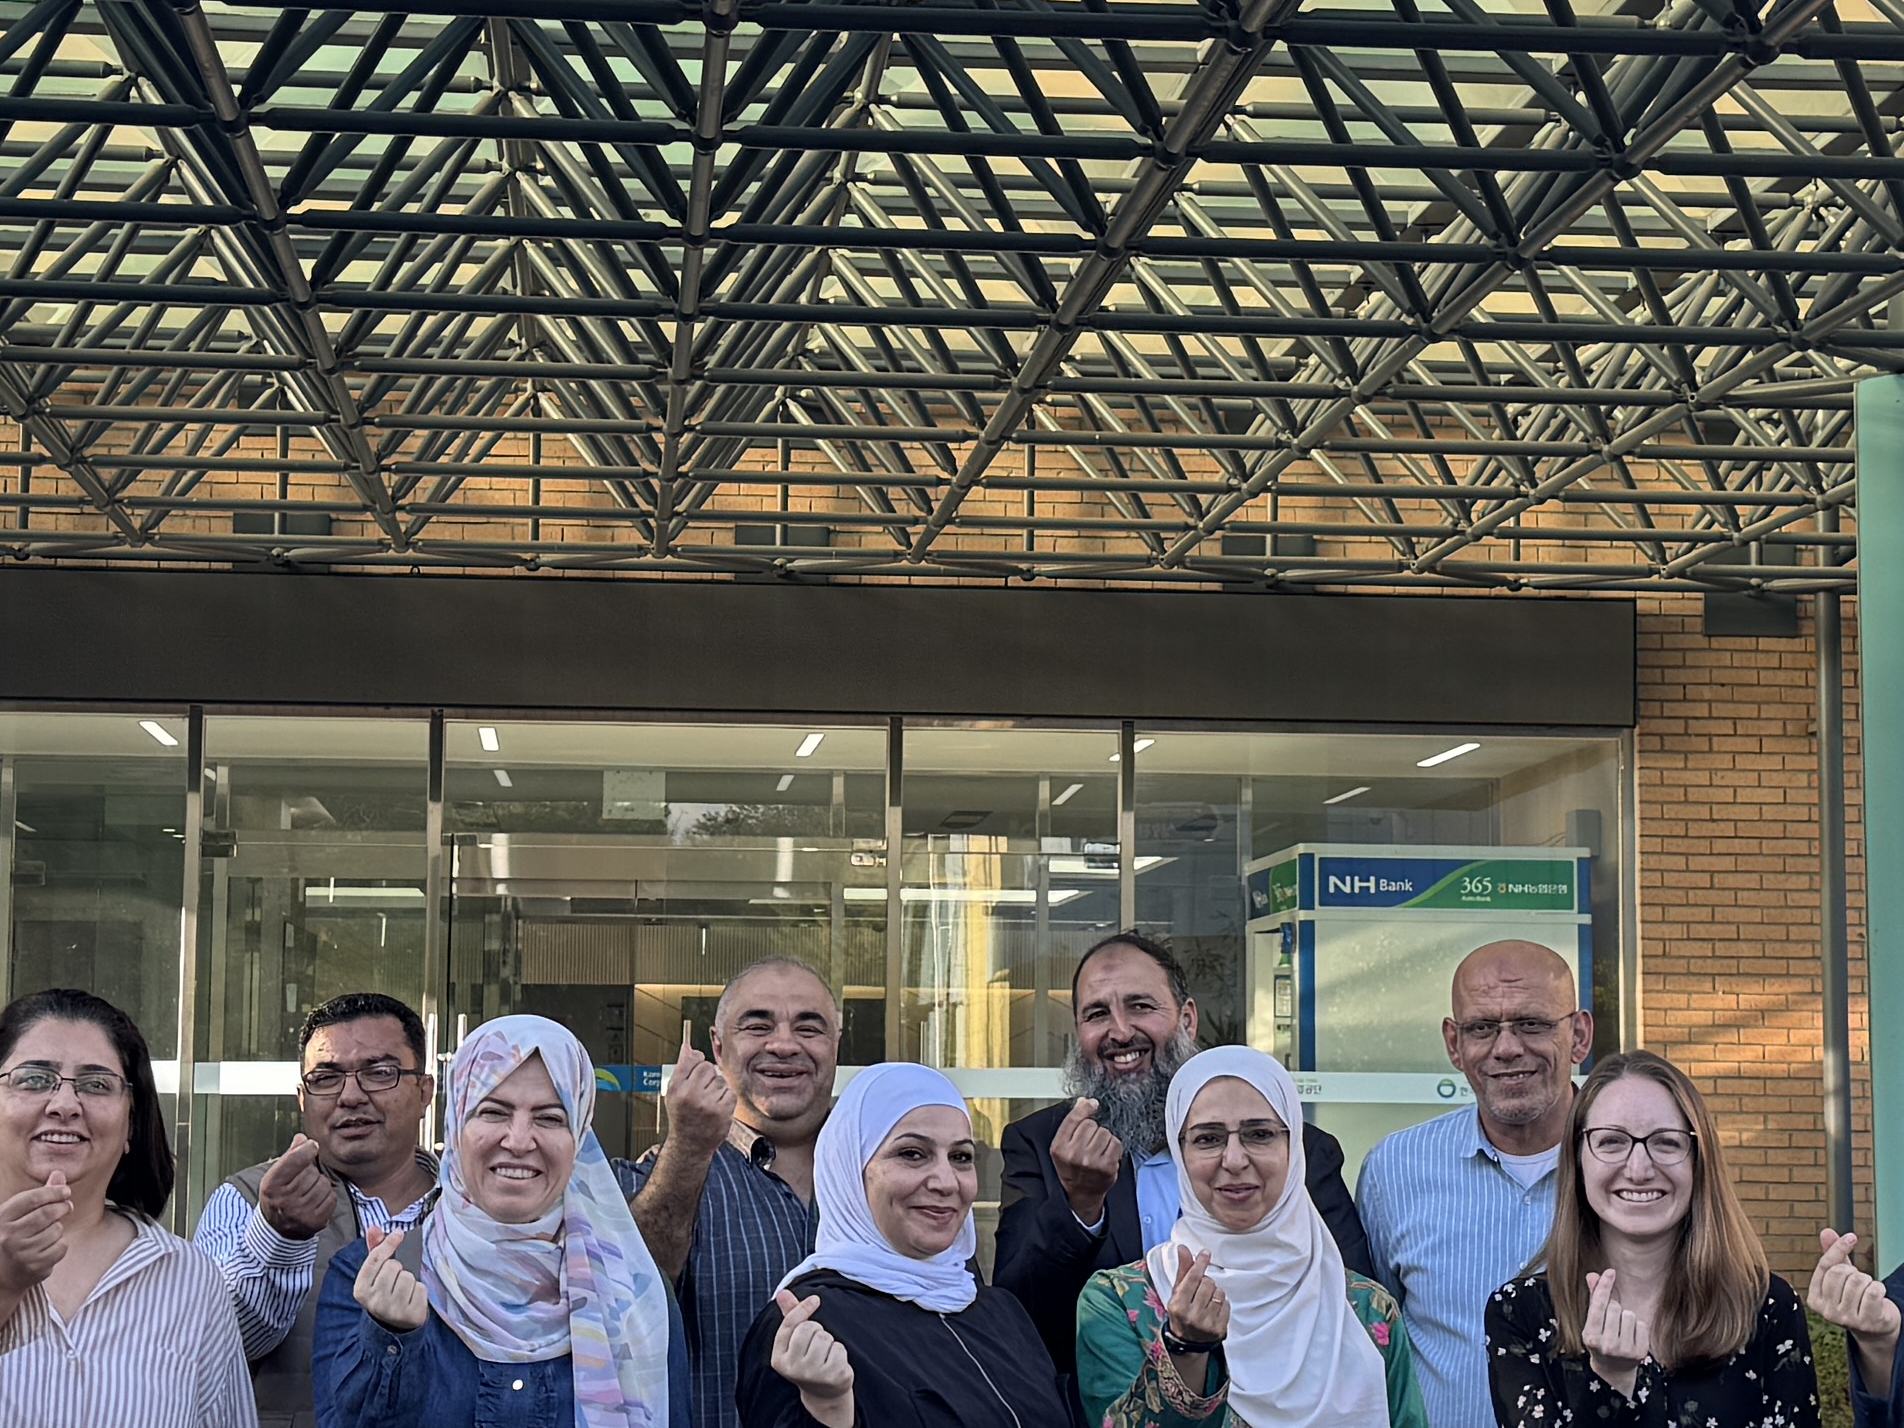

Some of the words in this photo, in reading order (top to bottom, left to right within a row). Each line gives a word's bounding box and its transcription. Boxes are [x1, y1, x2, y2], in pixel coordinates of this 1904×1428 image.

[1328, 875, 1376, 894] NH
[1379, 879, 1413, 892] Bank
[1460, 876, 1492, 894] 365
